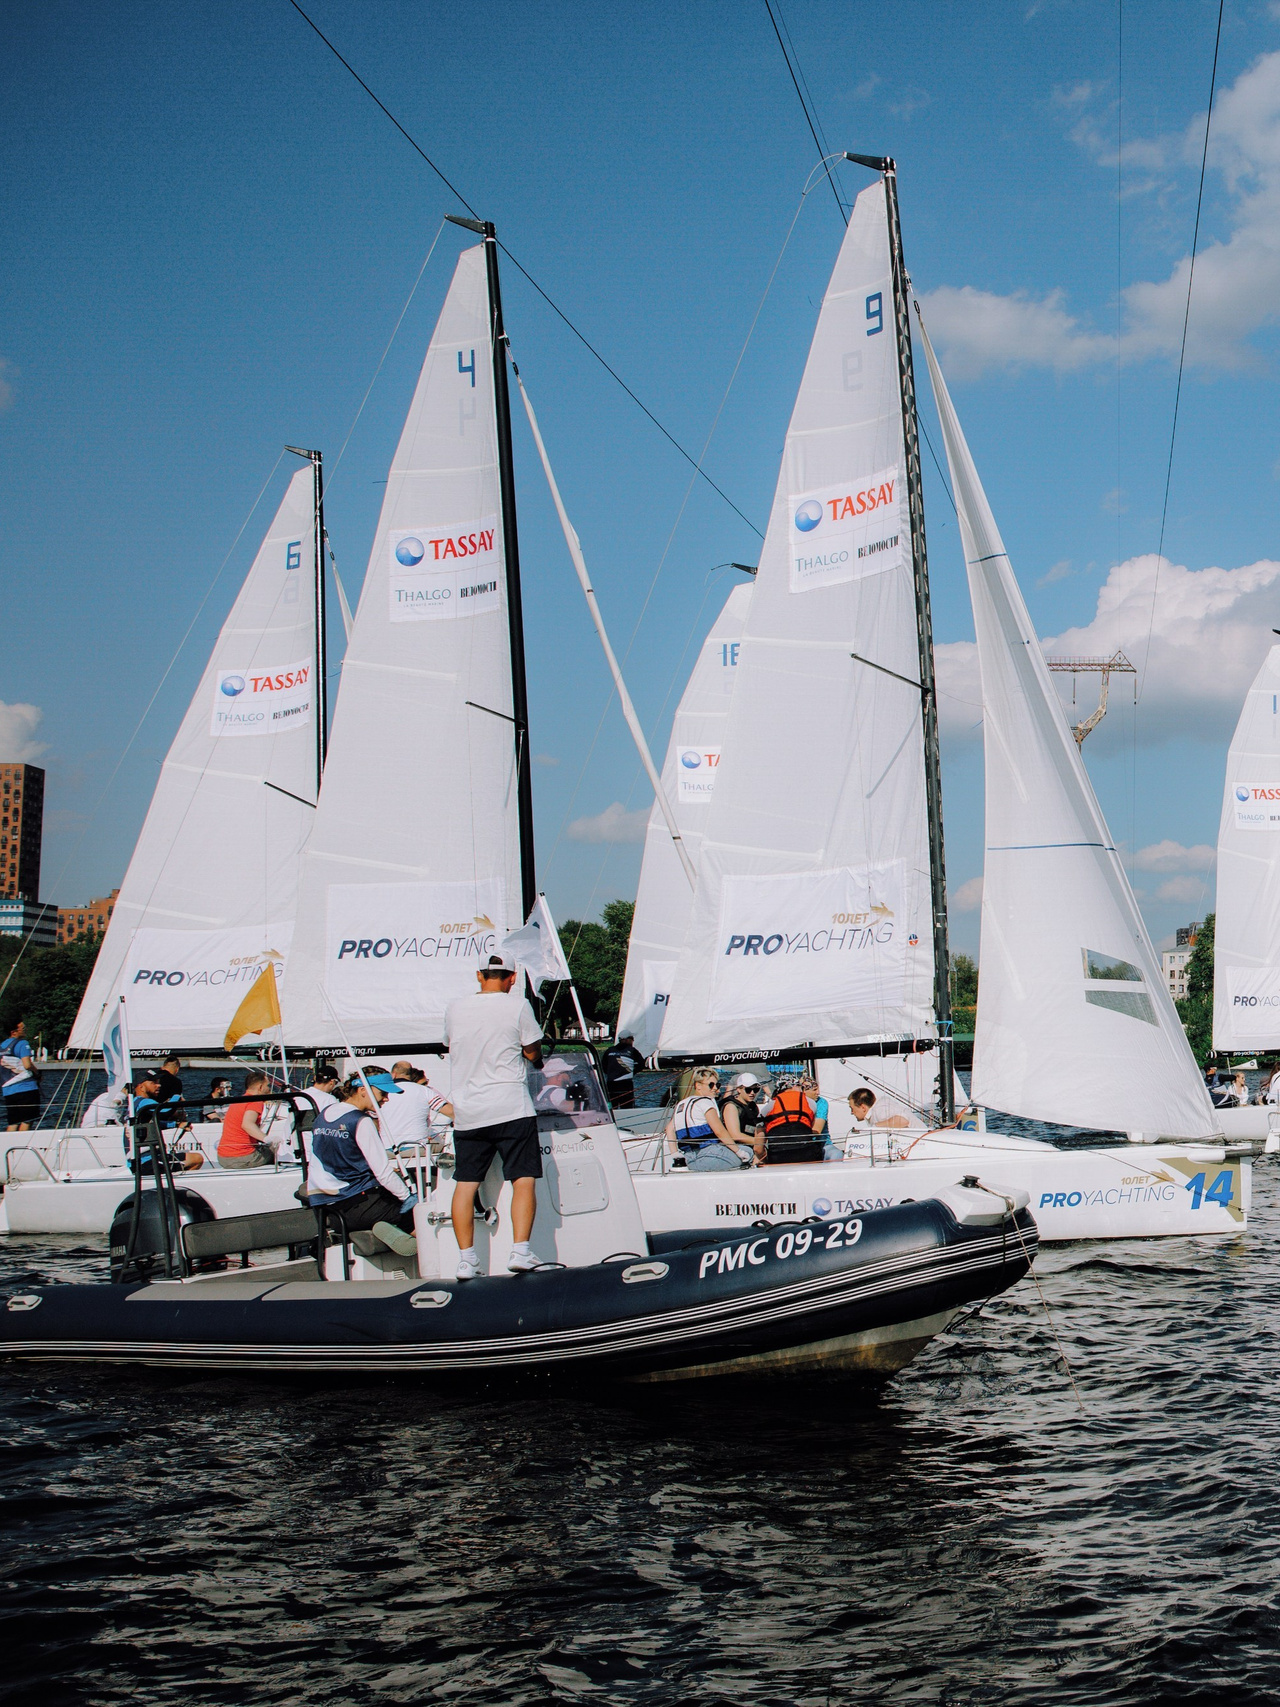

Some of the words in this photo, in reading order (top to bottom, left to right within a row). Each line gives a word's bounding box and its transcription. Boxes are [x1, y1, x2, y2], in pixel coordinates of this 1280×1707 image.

[865, 291, 884, 337] 9
[457, 349, 476, 388] 4
[826, 479, 895, 521] TASSAY
[286, 541, 301, 570] 6
[428, 528, 495, 560] TASSAY
[794, 550, 849, 572] THALGO
[394, 588, 451, 602] THALGO
[249, 666, 310, 693] TASSAY
[216, 712, 265, 722] THALGO
[681, 781, 715, 791] THALG
[1237, 812, 1265, 821] THALGO
[337, 934, 496, 960] PROYACHTING
[725, 922, 895, 956] PROYACHTING
[133, 962, 284, 987] PROYACHTING
[315, 1047, 376, 1058] pro-yacing.ru
[713, 1048, 780, 1064] pro-yachting.ru
[540, 1141, 595, 1156] ROYACHTING
[1039, 1184, 1175, 1209] PROYACHTING
[1184, 1170, 1234, 1210] 14
[715, 1202, 798, 1218] ВЕДОМОСТИ
[834, 1197, 894, 1213] TASSAY
[775, 1218, 863, 1260] 09-29
